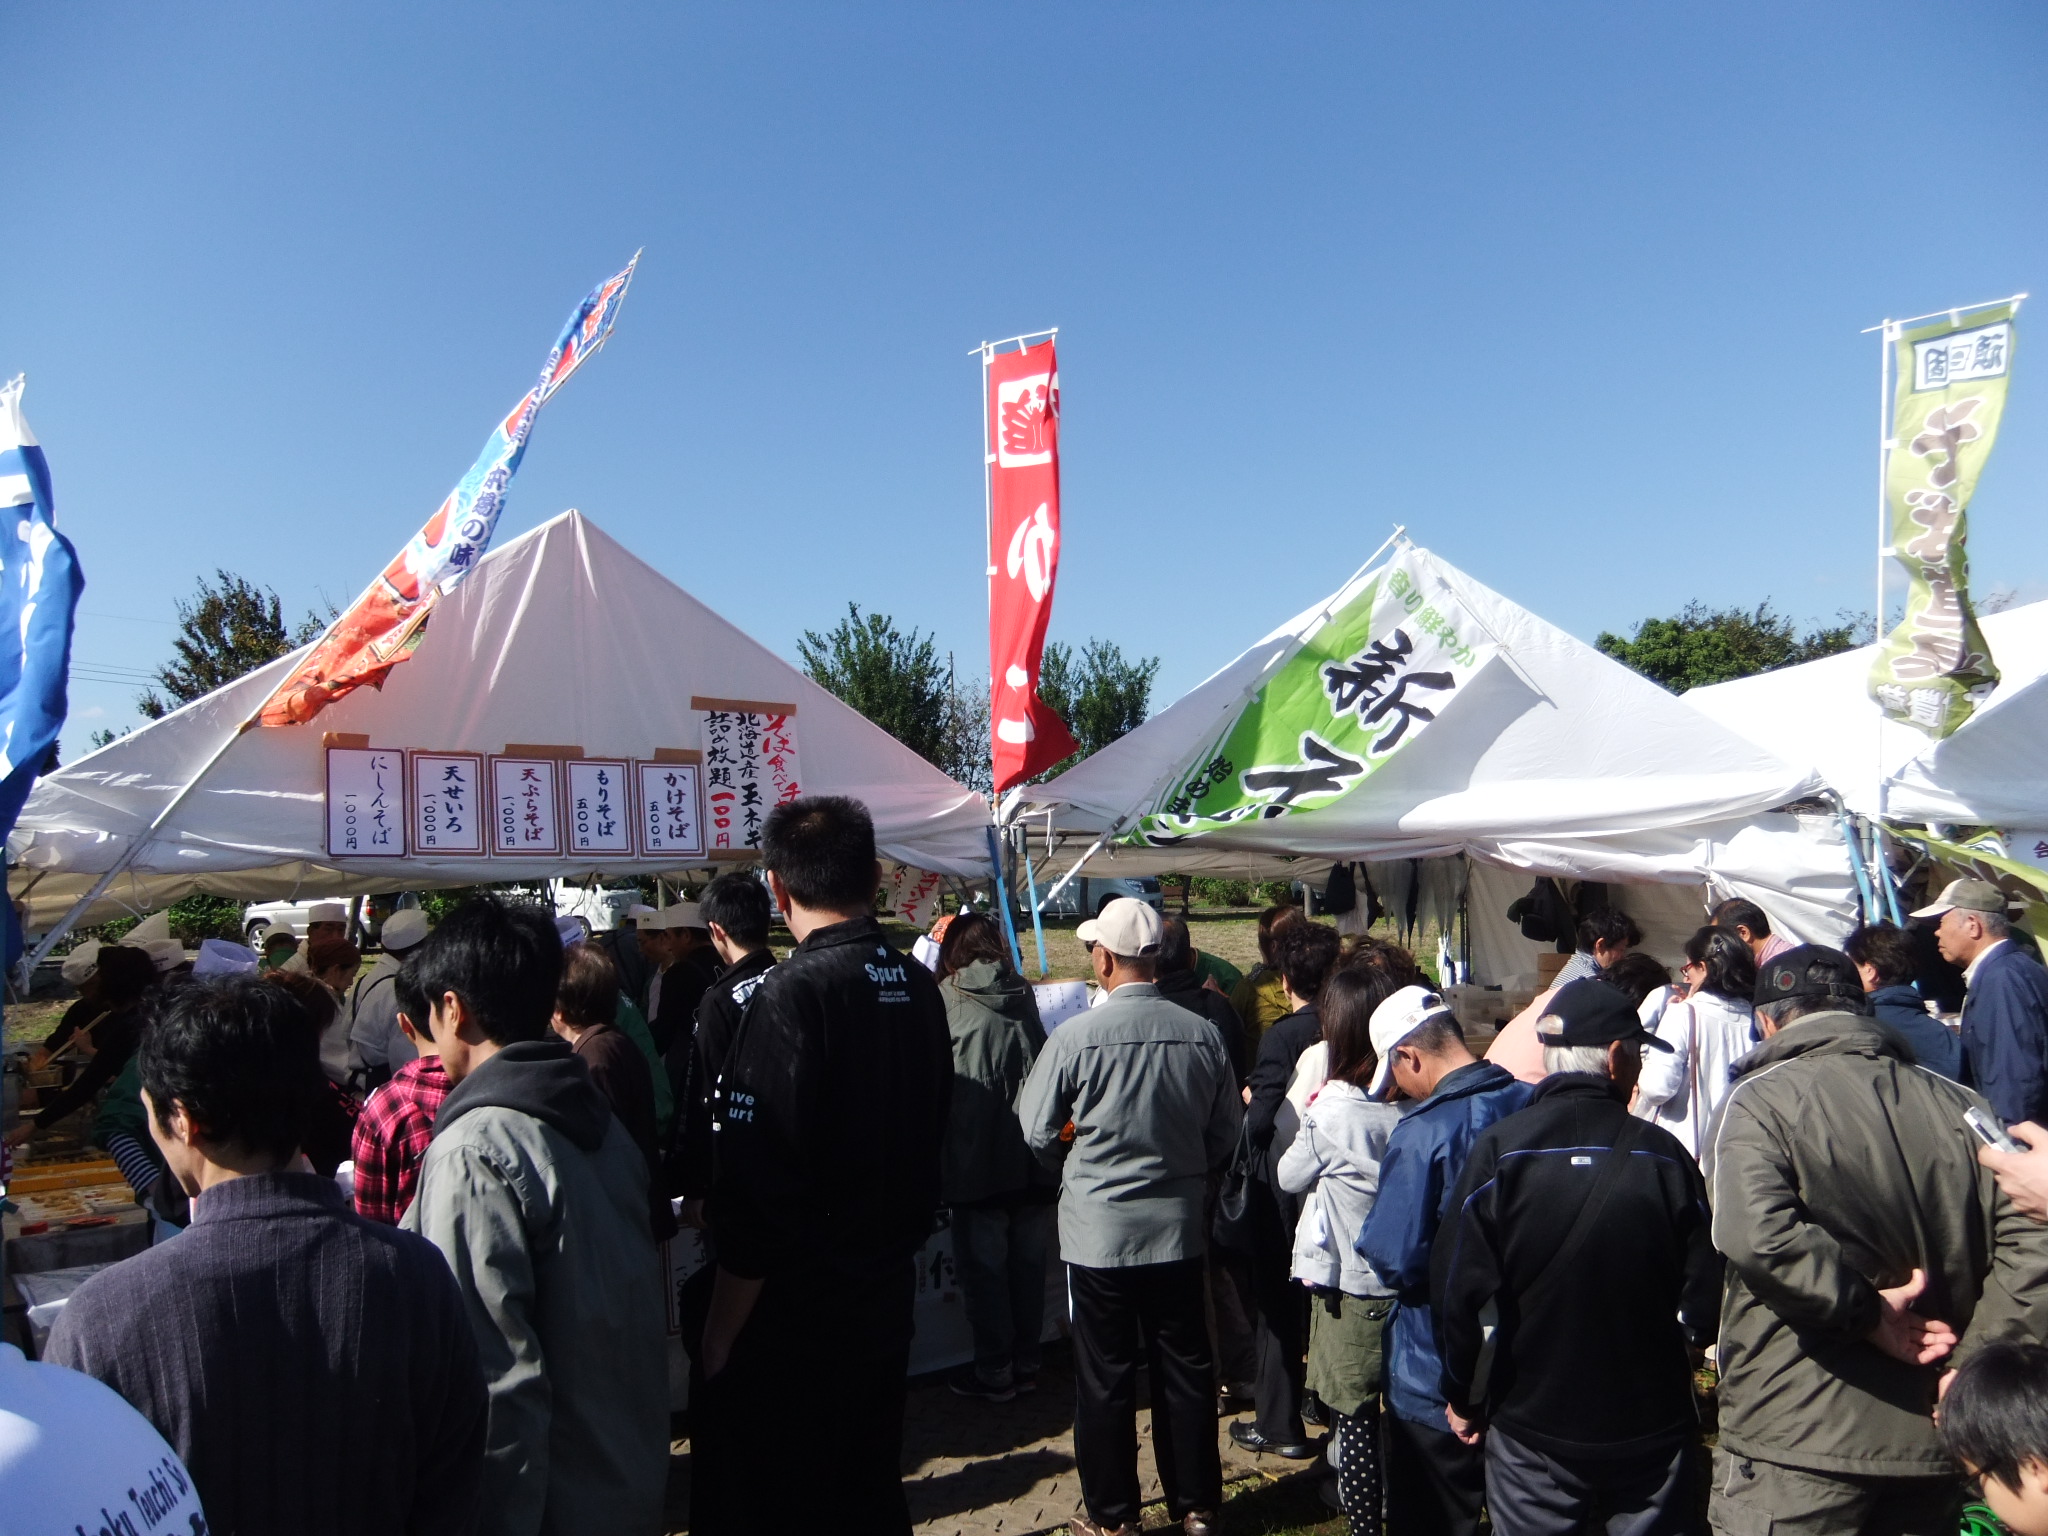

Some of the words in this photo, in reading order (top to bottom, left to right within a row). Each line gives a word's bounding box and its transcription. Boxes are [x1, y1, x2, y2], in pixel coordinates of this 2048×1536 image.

[370, 755, 393, 846] にしんそば
[442, 765, 467, 834] 天せいろ
[520, 768, 545, 842] 天ぷらそば
[596, 769, 616, 838] もりそば
[663, 772, 690, 840] かけそば
[864, 963, 908, 986] Spurt
[127, 1466, 179, 1531] Teuchi
